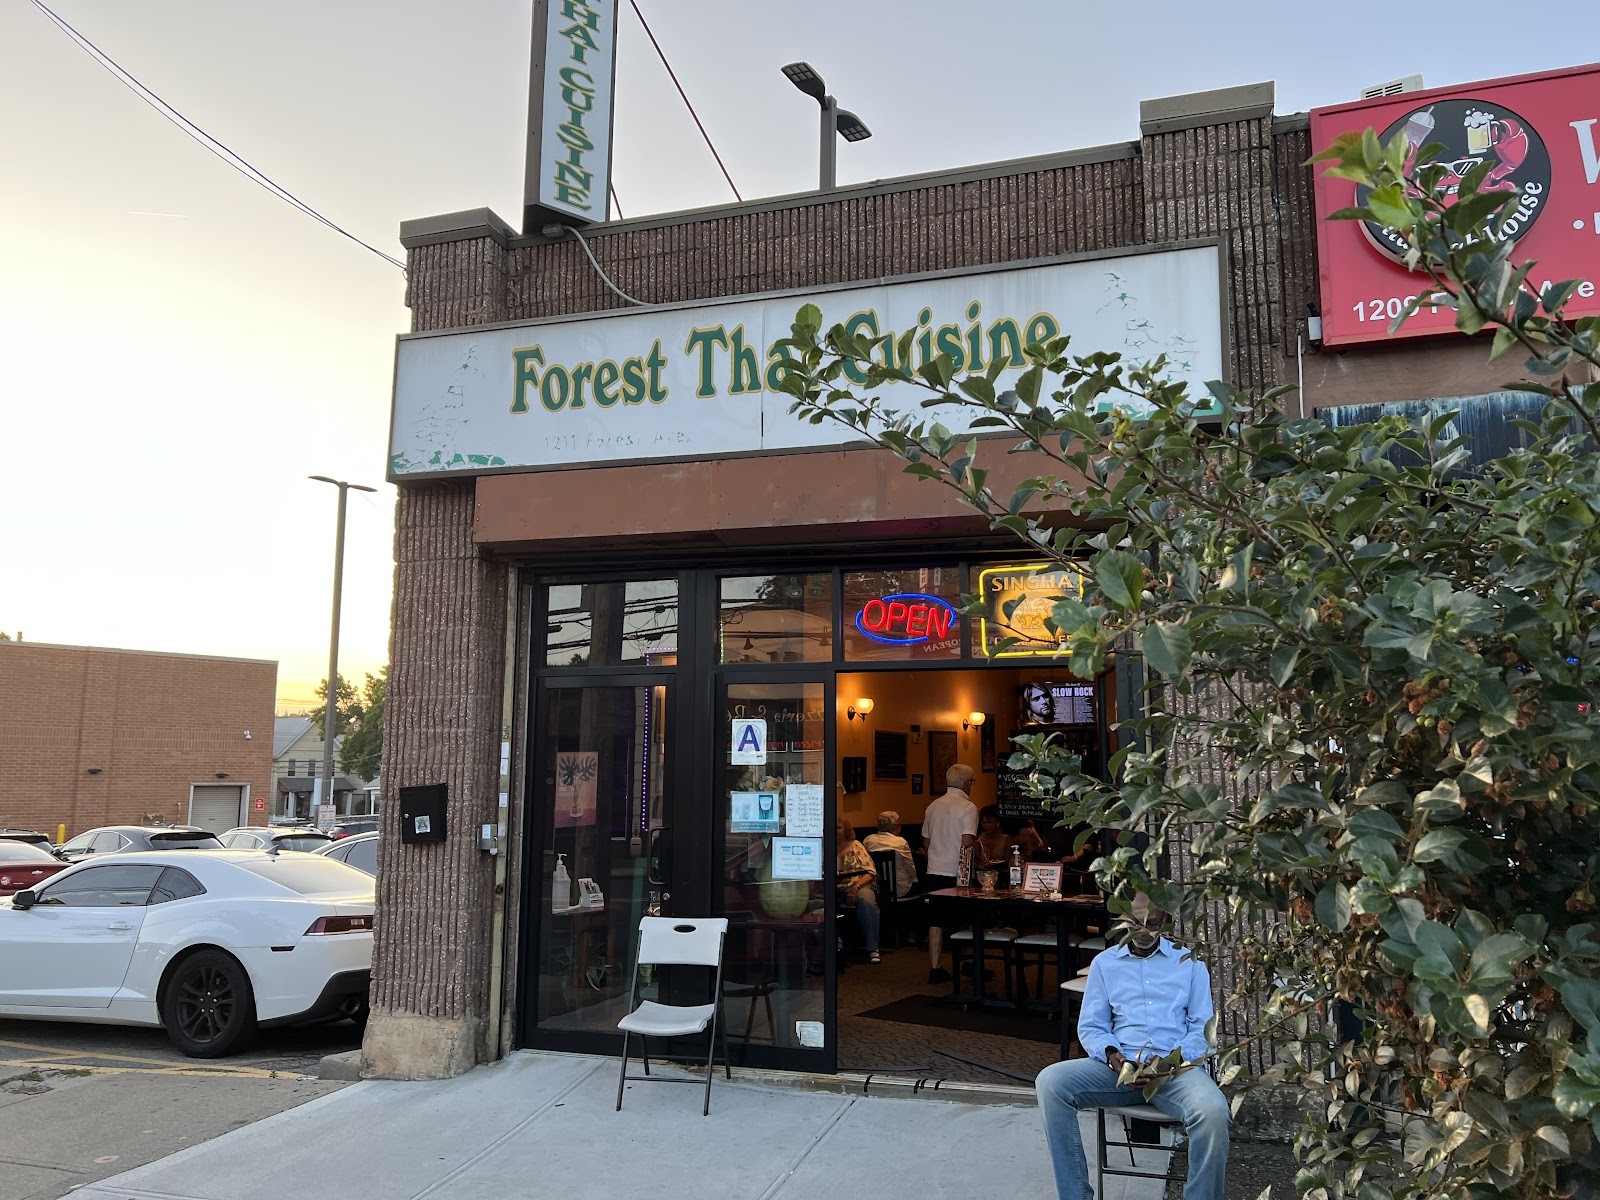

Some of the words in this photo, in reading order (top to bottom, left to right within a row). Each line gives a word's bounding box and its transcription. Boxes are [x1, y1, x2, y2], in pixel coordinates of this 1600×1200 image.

[558, 0, 601, 65] HAI
[553, 65, 596, 212] CUISINE
[508, 337, 669, 415] Forest
[685, 322, 820, 399] Tha
[840, 299, 1061, 387] Cuisine
[991, 574, 1074, 592] SINGHA
[862, 598, 950, 639] OPEN
[1052, 687, 1072, 697] SLOW
[1074, 686, 1094, 697] ROCK
[737, 724, 761, 752] A
